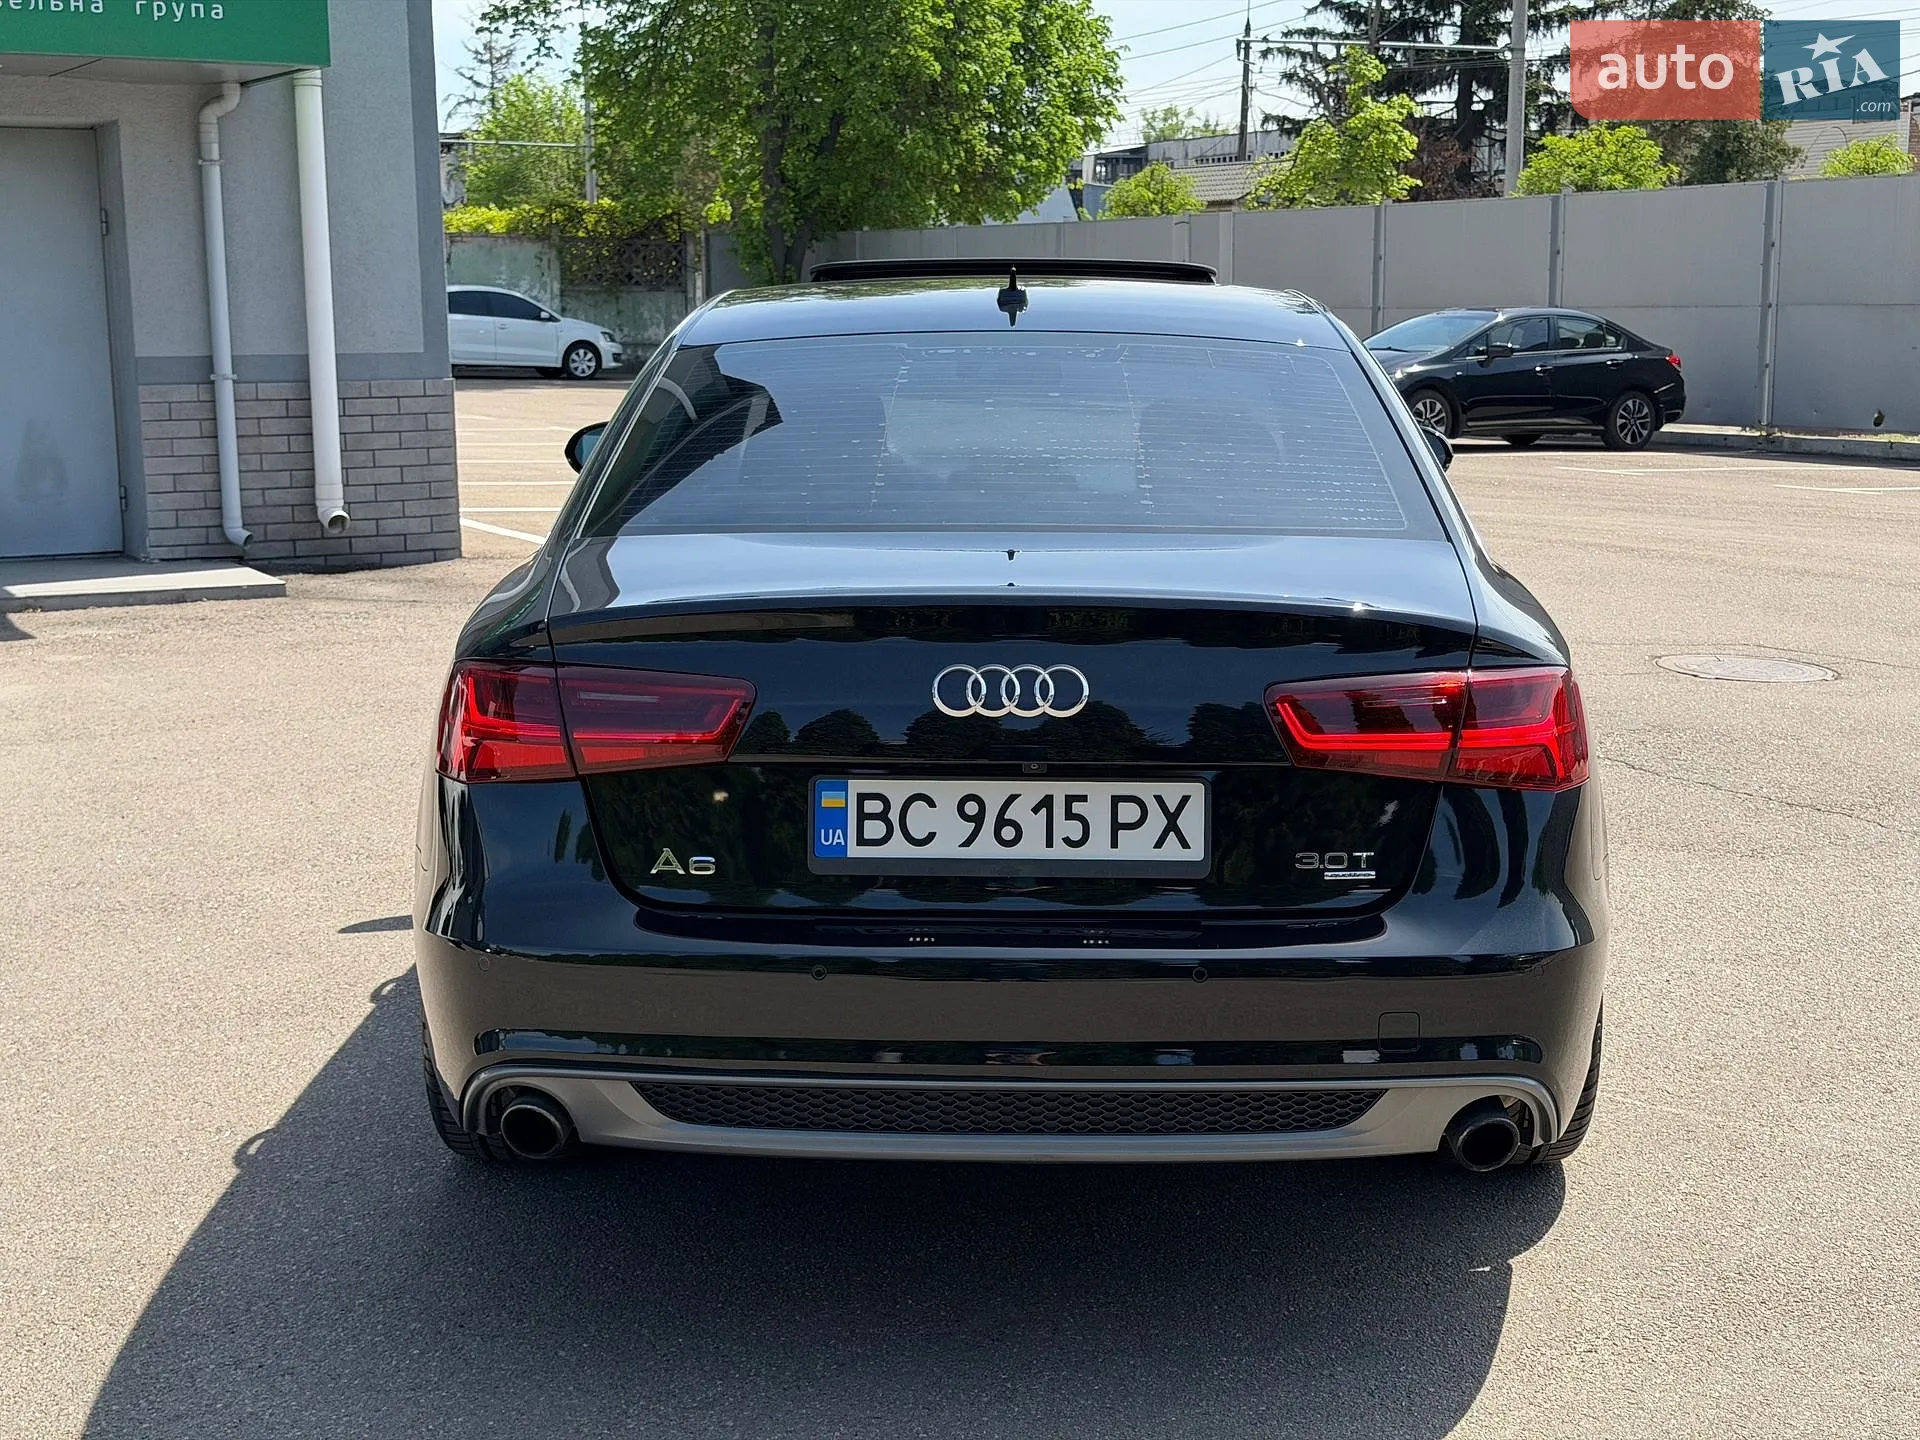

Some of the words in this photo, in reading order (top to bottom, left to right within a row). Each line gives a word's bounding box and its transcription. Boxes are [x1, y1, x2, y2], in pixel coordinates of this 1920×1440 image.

[0, 0, 104, 13] ельна
[135, 0, 224, 22] група
[855, 792, 938, 848] BC
[956, 793, 1091, 849] 9615
[1109, 794, 1193, 850] PX
[820, 828, 846, 846] UA
[650, 847, 716, 875] A6
